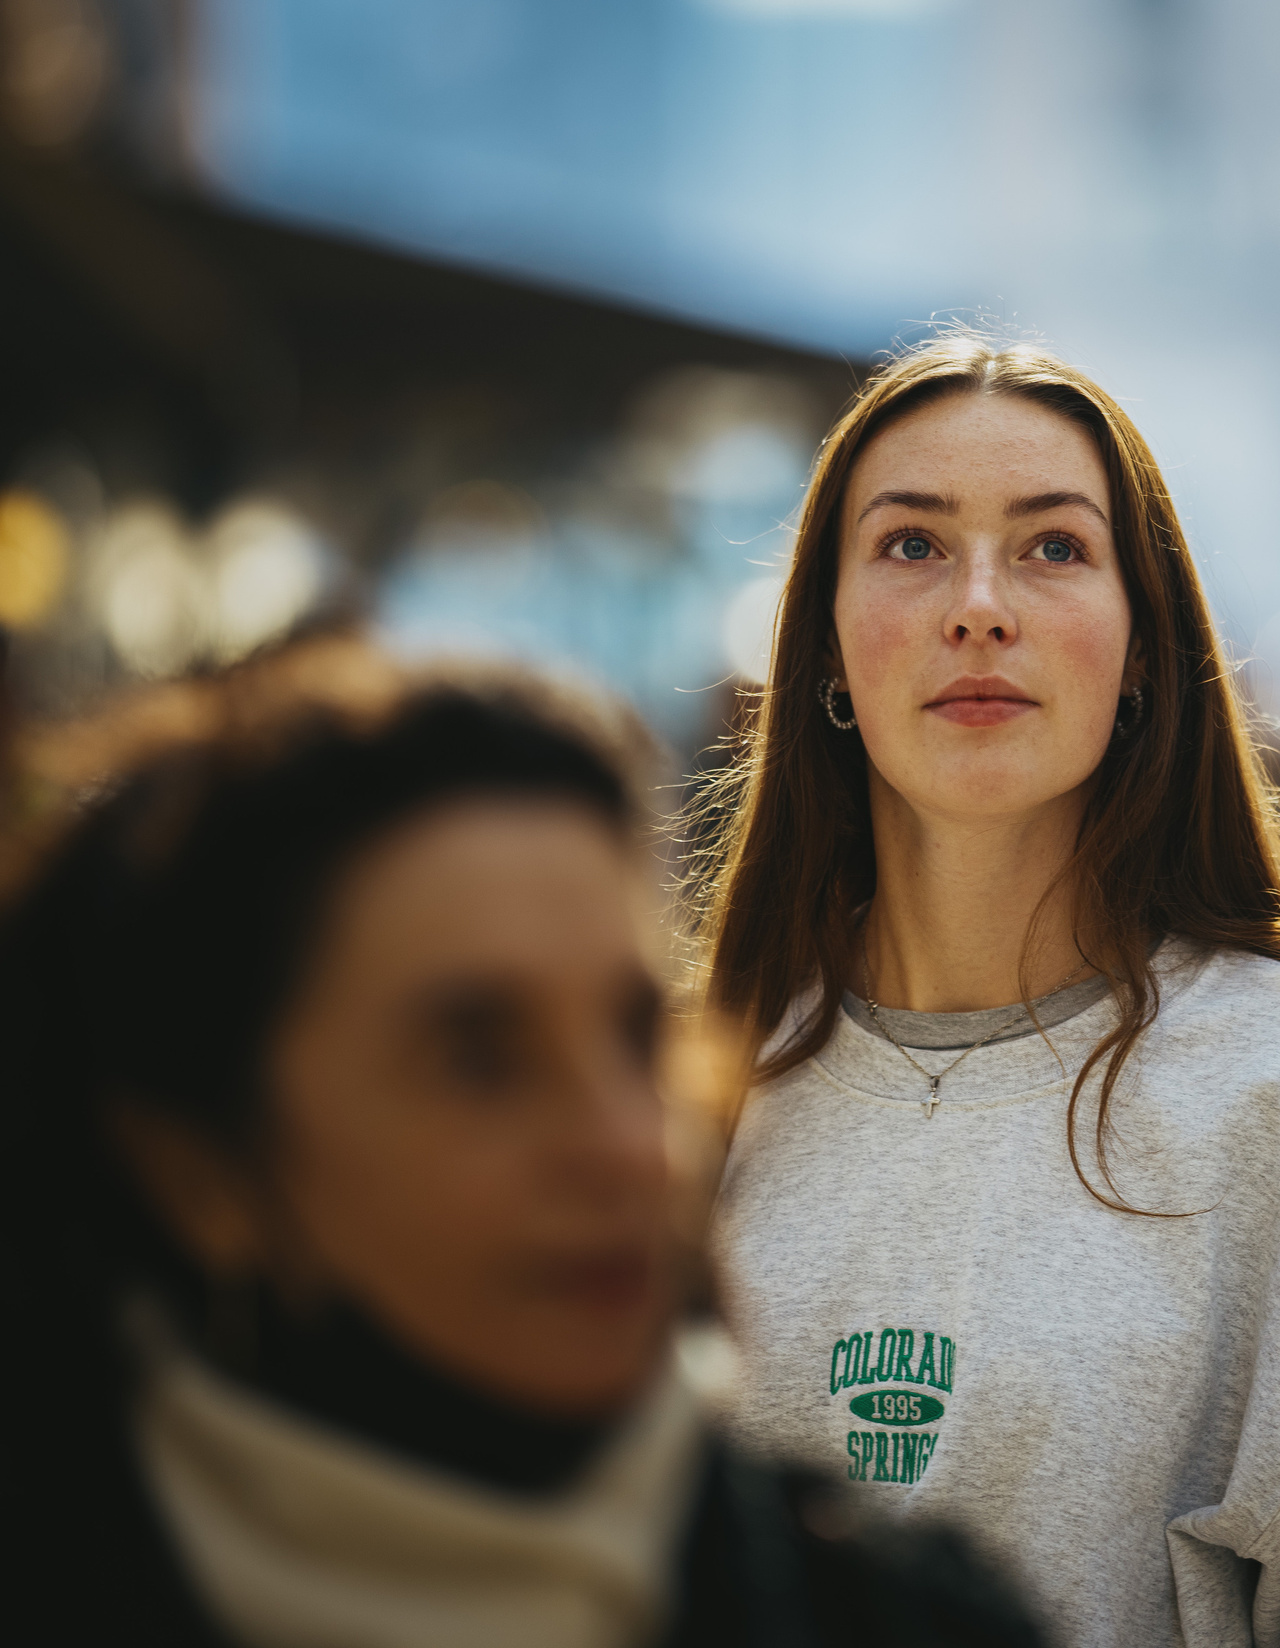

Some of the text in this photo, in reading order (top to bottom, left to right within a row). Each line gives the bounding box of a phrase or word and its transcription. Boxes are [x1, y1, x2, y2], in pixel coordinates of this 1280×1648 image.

[830, 1328, 956, 1395] COLORAD
[871, 1395, 922, 1421] 1995
[847, 1431, 939, 1484] SPRING
